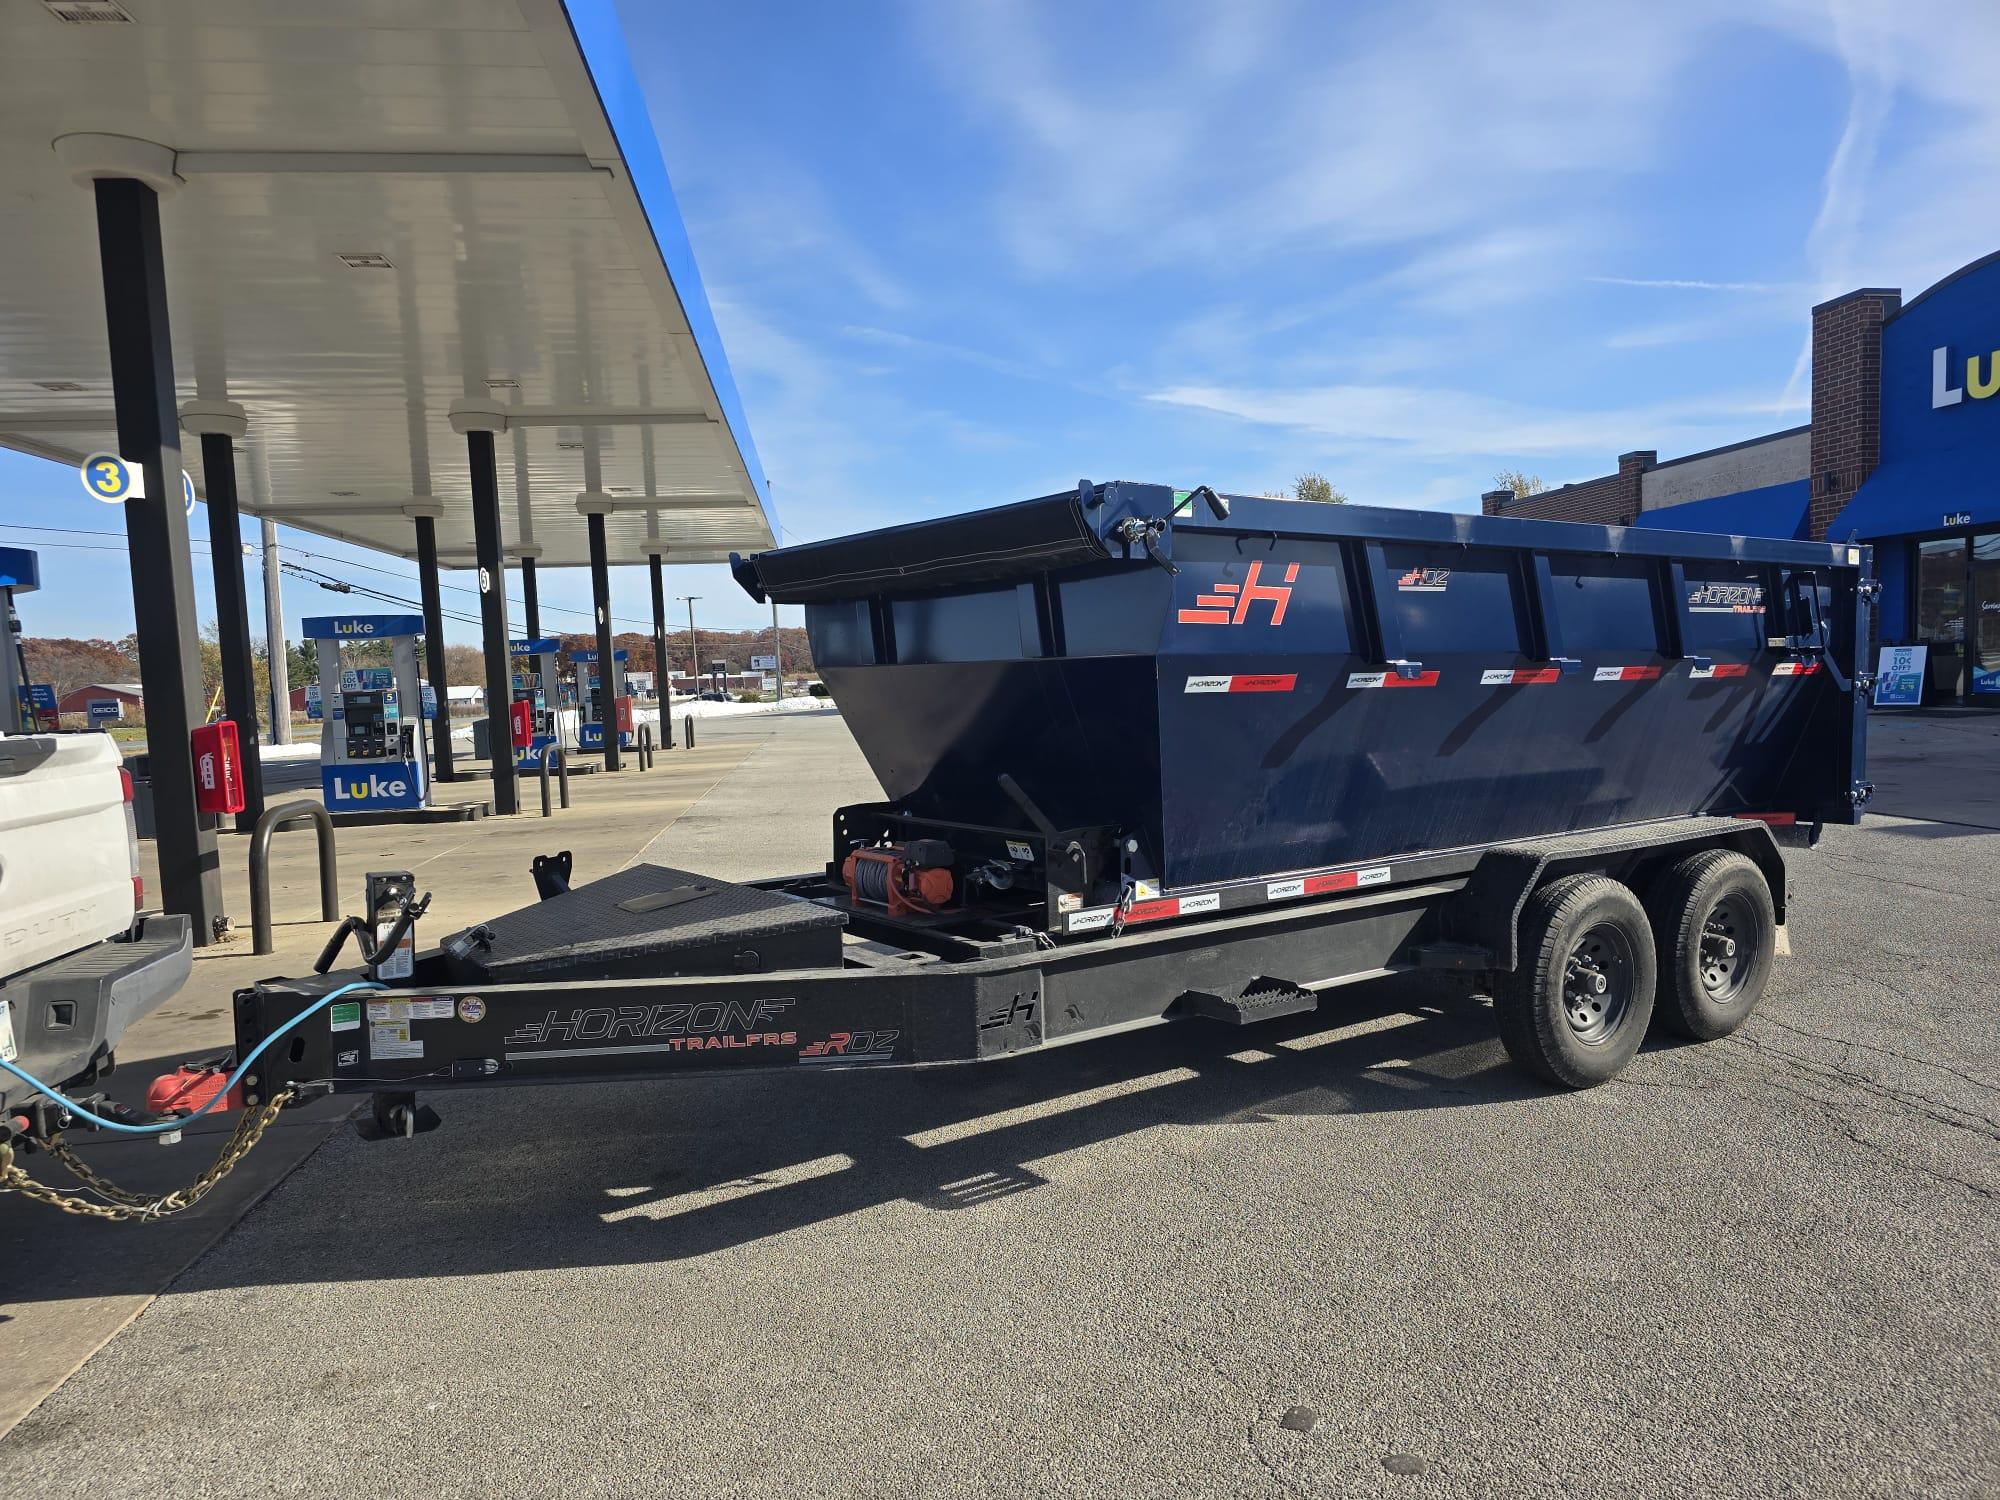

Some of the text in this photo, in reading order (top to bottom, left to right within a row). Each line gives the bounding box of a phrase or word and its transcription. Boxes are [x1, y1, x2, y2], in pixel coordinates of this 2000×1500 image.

[96, 461, 122, 493] 3
[1943, 512, 1970, 527] Luke
[1693, 585, 1763, 605] HORIZON
[334, 620, 374, 634] Luke
[510, 643, 530, 652] uke
[1189, 680, 1229, 688] HORIZON
[387, 693, 393, 701] 5
[585, 730, 603, 742] Lu
[334, 774, 407, 799] Luke
[1360, 871, 1388, 881] HORIZON
[1270, 884, 1302, 895] HORIZON
[1182, 897, 1217, 909] HORIZON
[1072, 912, 1112, 925] HORIZON
[522, 998, 780, 1043] HORIZON
